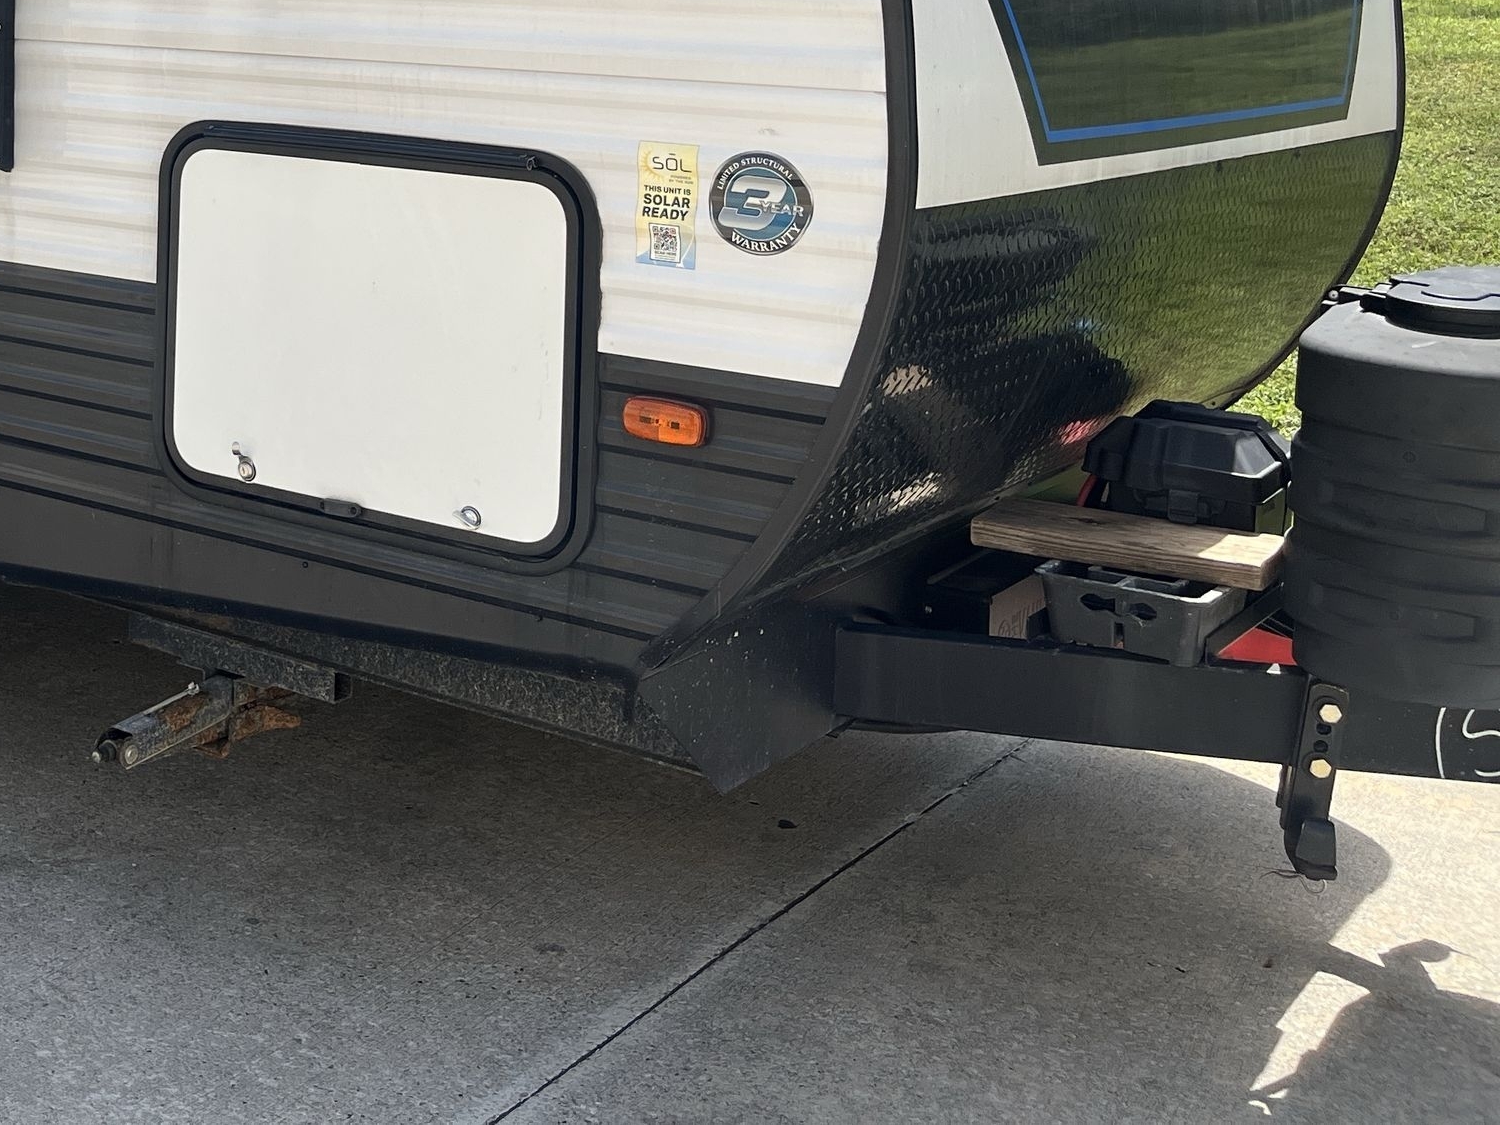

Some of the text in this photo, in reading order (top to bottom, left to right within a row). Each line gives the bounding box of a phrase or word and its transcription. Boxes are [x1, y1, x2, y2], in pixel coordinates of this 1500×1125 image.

[717, 156, 794, 190] LIMITED STRUCTURAL
[643, 184, 692, 196] THIS UNIT IS
[643, 192, 691, 209] SOLAR
[642, 205, 689, 222] READY
[717, 175, 805, 231] 3 YEAR
[730, 223, 802, 253] WARRANTY
